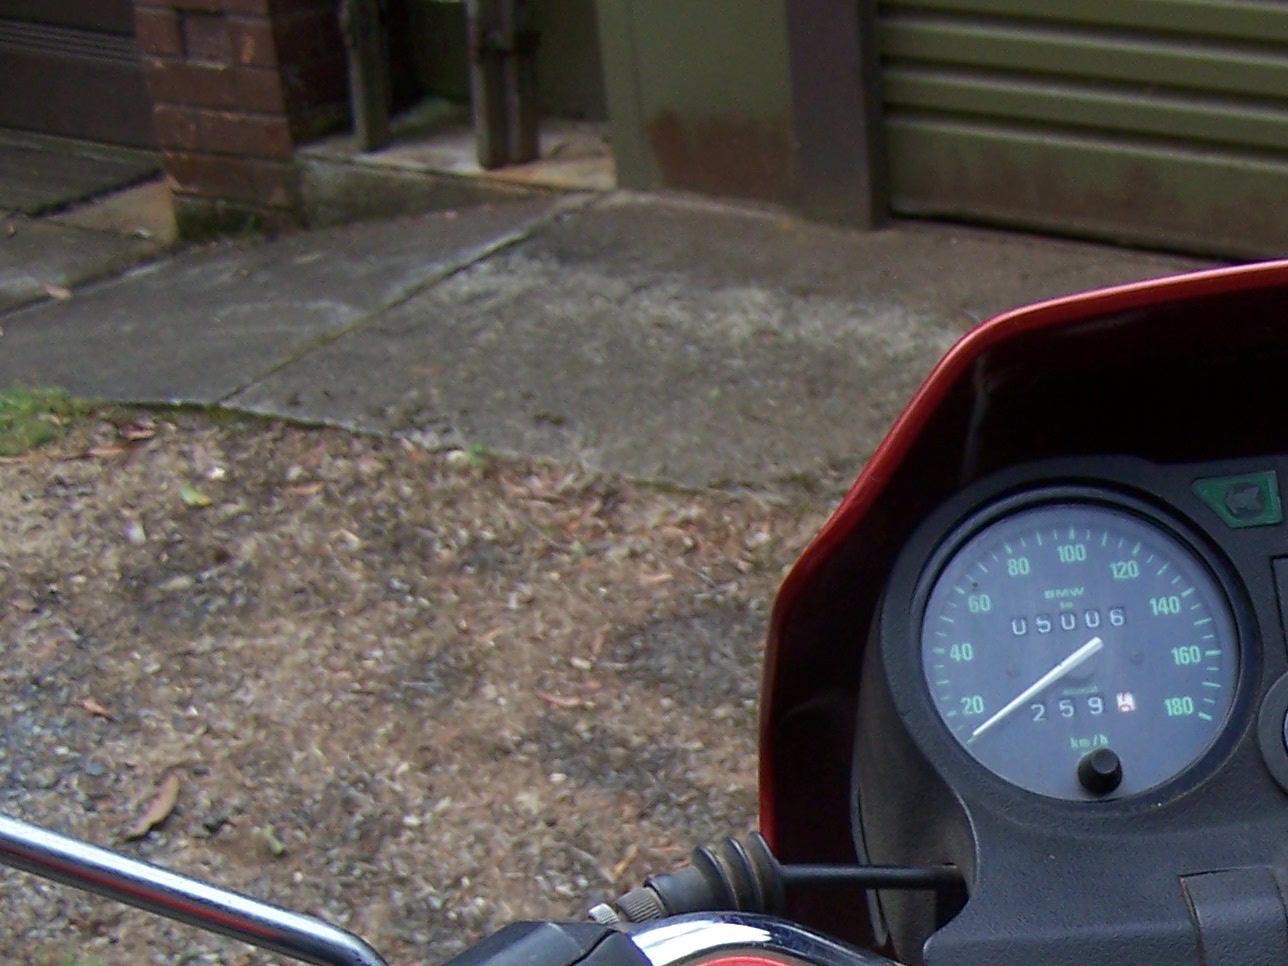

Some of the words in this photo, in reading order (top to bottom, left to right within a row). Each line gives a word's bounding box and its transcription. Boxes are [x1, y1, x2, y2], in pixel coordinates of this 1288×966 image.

[1057, 544, 1086, 563] 100
[1008, 557, 1030, 576] 80
[1110, 560, 1140, 579] 120
[1044, 587, 1084, 599] BMW
[968, 594, 991, 613] 60
[1149, 596, 1182, 615] 140
[950, 643, 974, 662] 40
[1171, 645, 1201, 665] 160
[961, 696, 985, 716] 20
[1164, 697, 1194, 716] 180
[1070, 733, 1109, 749] km/h
